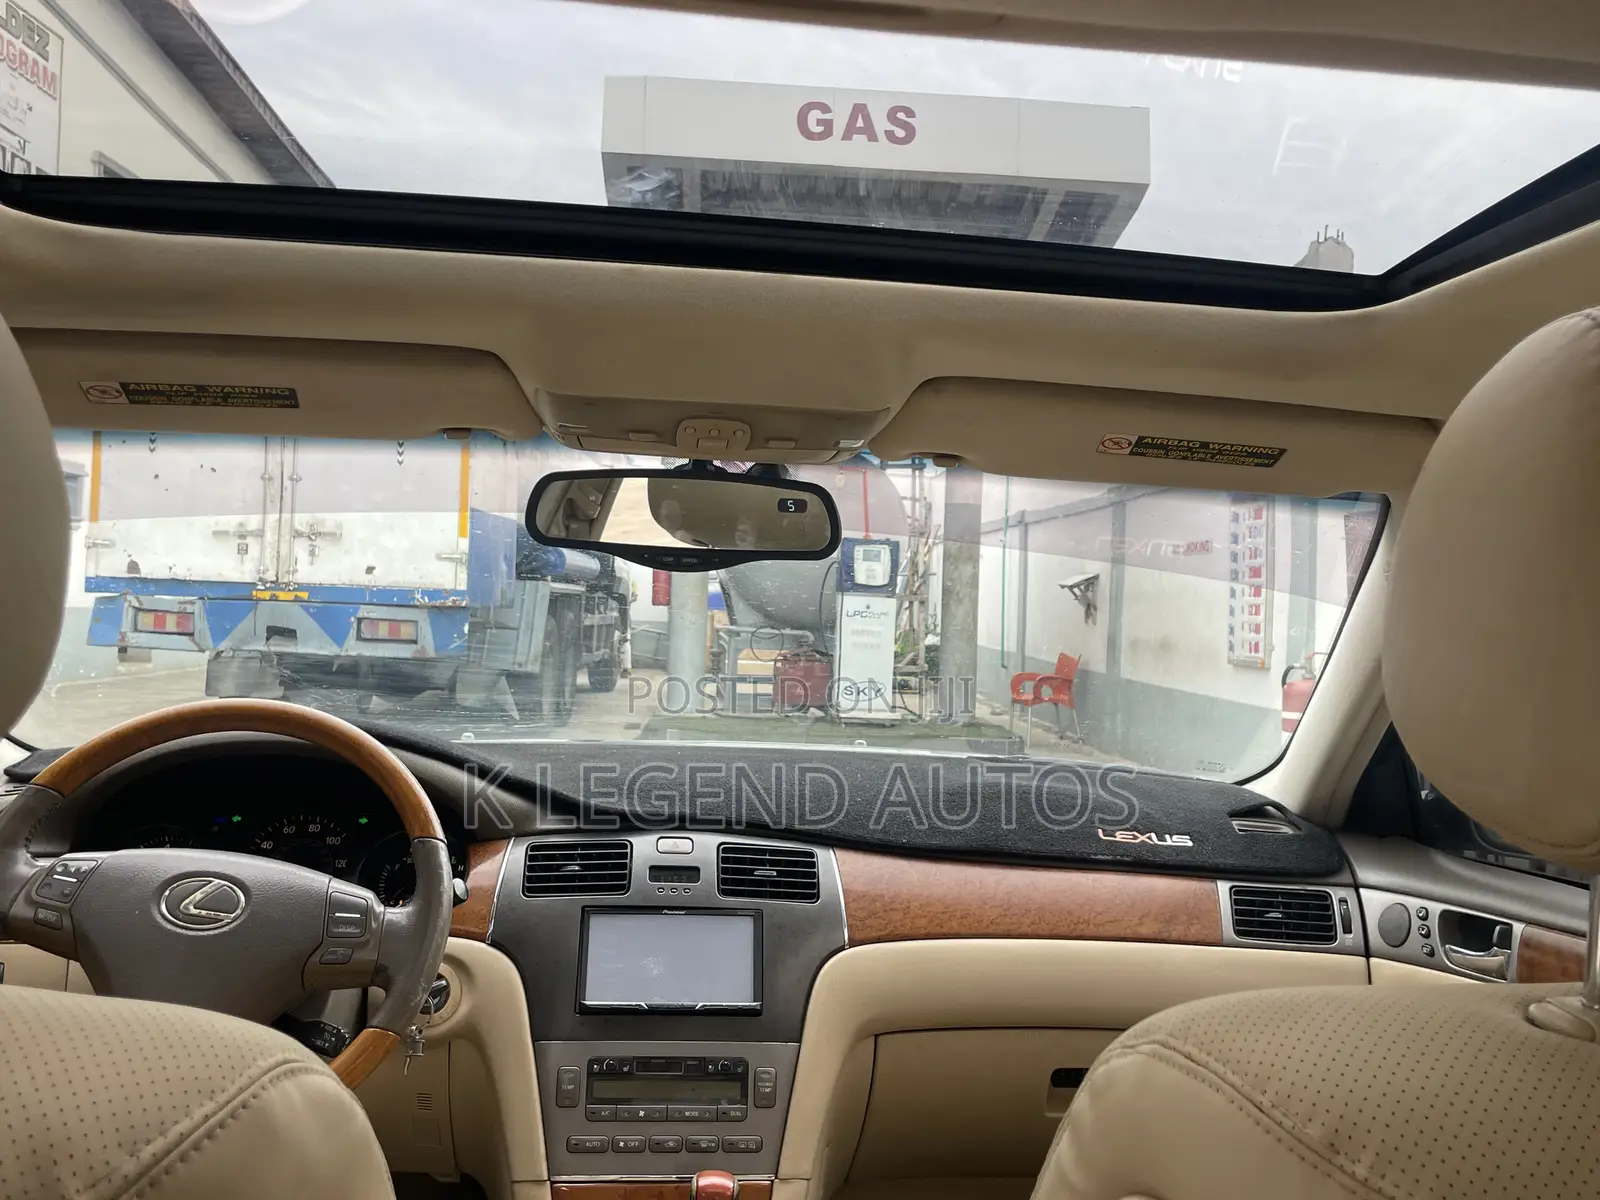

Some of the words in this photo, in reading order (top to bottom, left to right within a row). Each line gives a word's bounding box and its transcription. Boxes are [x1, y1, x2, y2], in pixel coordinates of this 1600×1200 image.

[0, 2, 50, 62] DEZ
[796, 101, 918, 146] GAS
[129, 383, 197, 392] AIRBAG
[206, 386, 290, 395] WARNING
[1142, 437, 1201, 449] AIRBAG
[1209, 443, 1281, 456] WARNING
[843, 684, 885, 698] SKY
[283, 825, 296, 834] 60
[308, 824, 321, 832] 80
[326, 836, 341, 845] 100
[1097, 828, 1194, 847] LEXUS
[260, 840, 274, 849] 40
